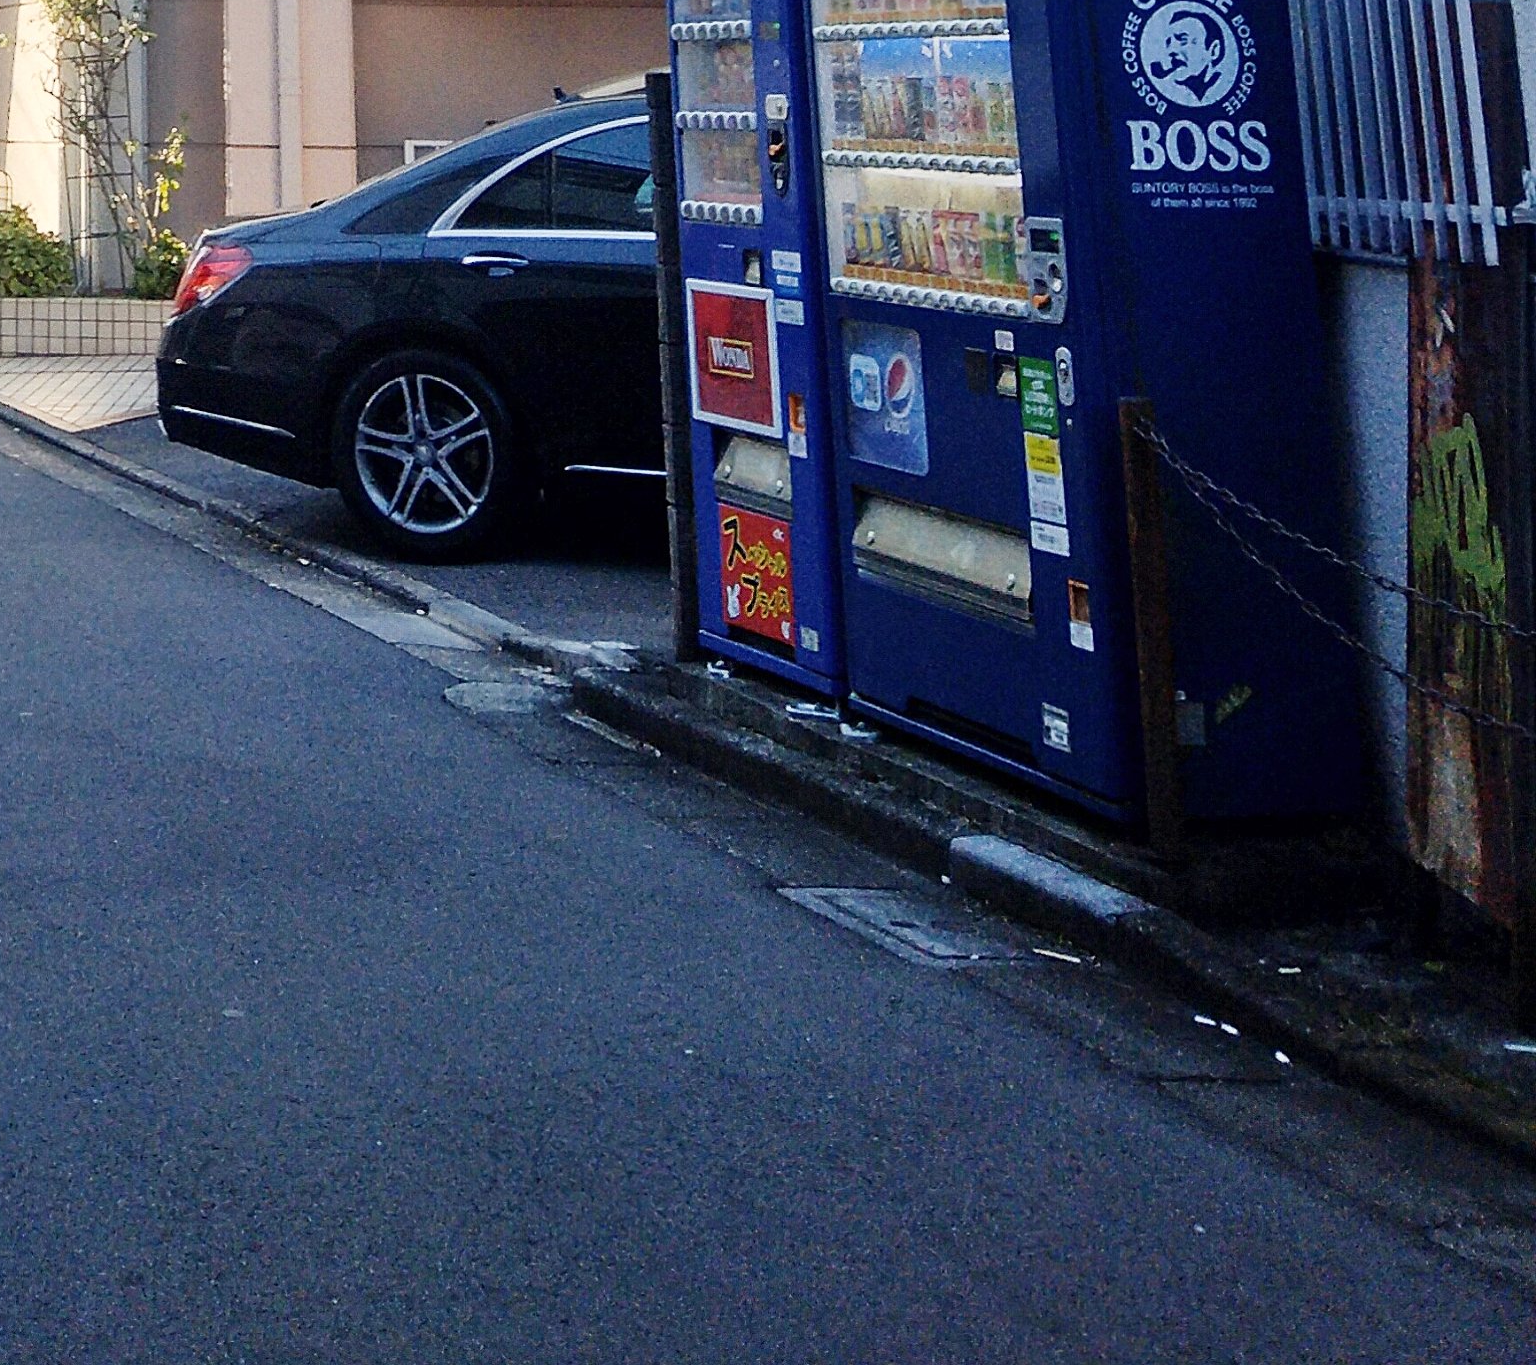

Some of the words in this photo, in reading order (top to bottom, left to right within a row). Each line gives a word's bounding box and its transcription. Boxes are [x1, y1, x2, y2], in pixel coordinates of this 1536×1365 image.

[1122, 12, 1142, 74] COFFEE
[1231, 14, 1256, 57] BOSS
[1131, 76, 1167, 115] BOSS
[1222, 61, 1257, 116] COFFEE
[1126, 120, 1271, 172] BOSS
[1131, 182, 1185, 194] SUNTORY
[1188, 182, 1219, 194] BOSS
